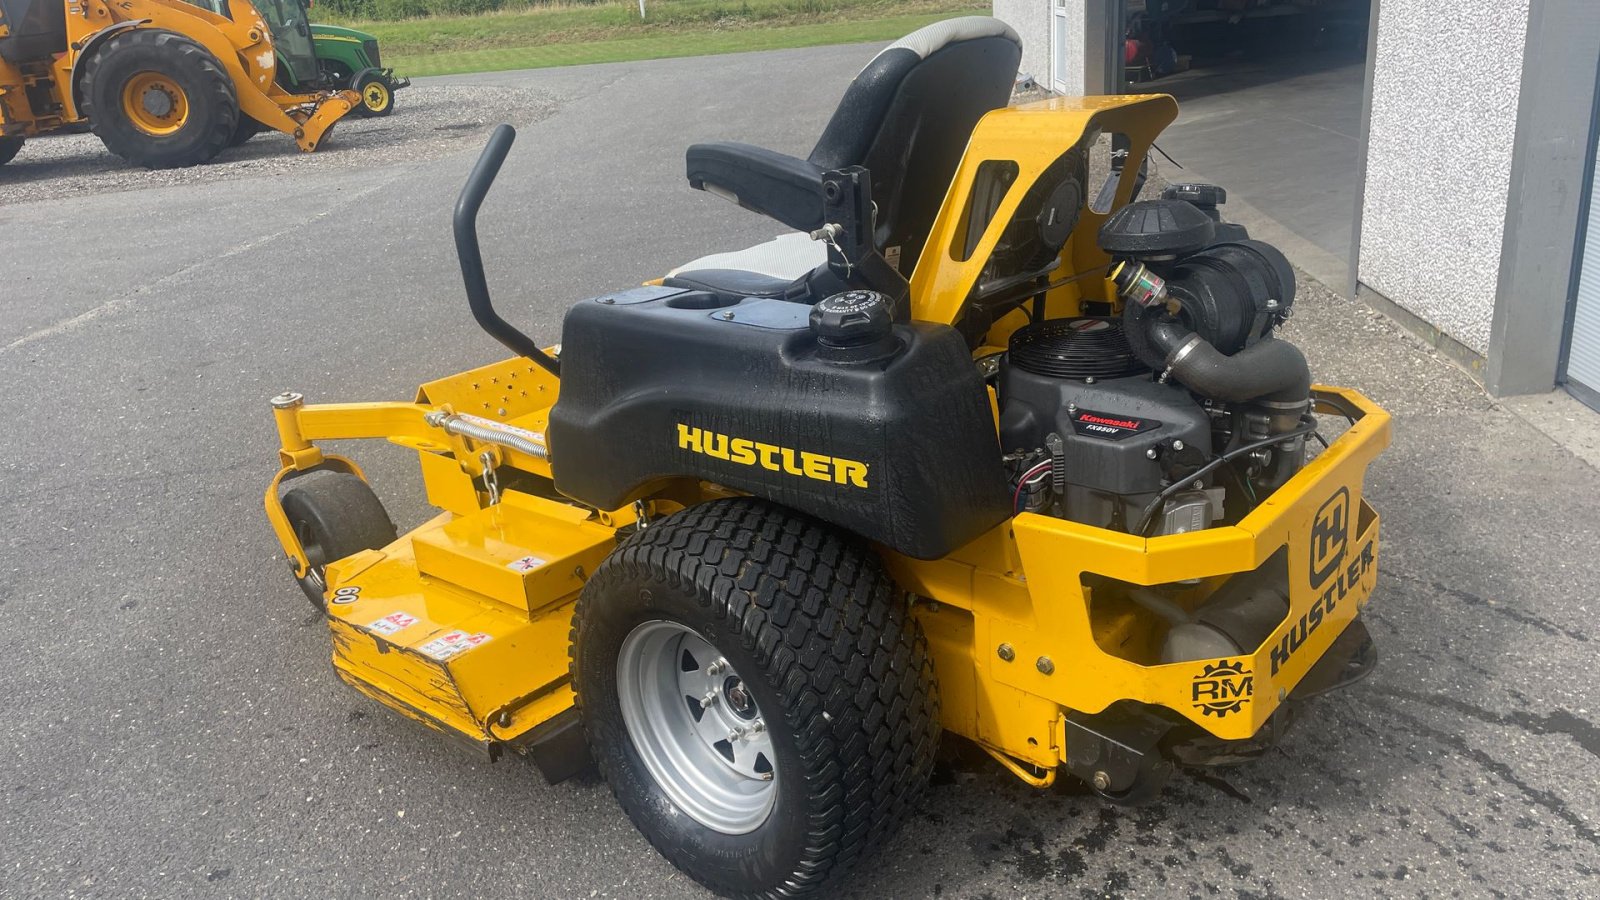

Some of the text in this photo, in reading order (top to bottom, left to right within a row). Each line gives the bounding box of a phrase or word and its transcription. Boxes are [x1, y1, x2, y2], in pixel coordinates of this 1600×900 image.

[1080, 414, 1139, 429] Kawasaki
[677, 423, 868, 488] HUSTLER
[1270, 539, 1375, 678] HUSTLER
[1192, 676, 1253, 702] RM
